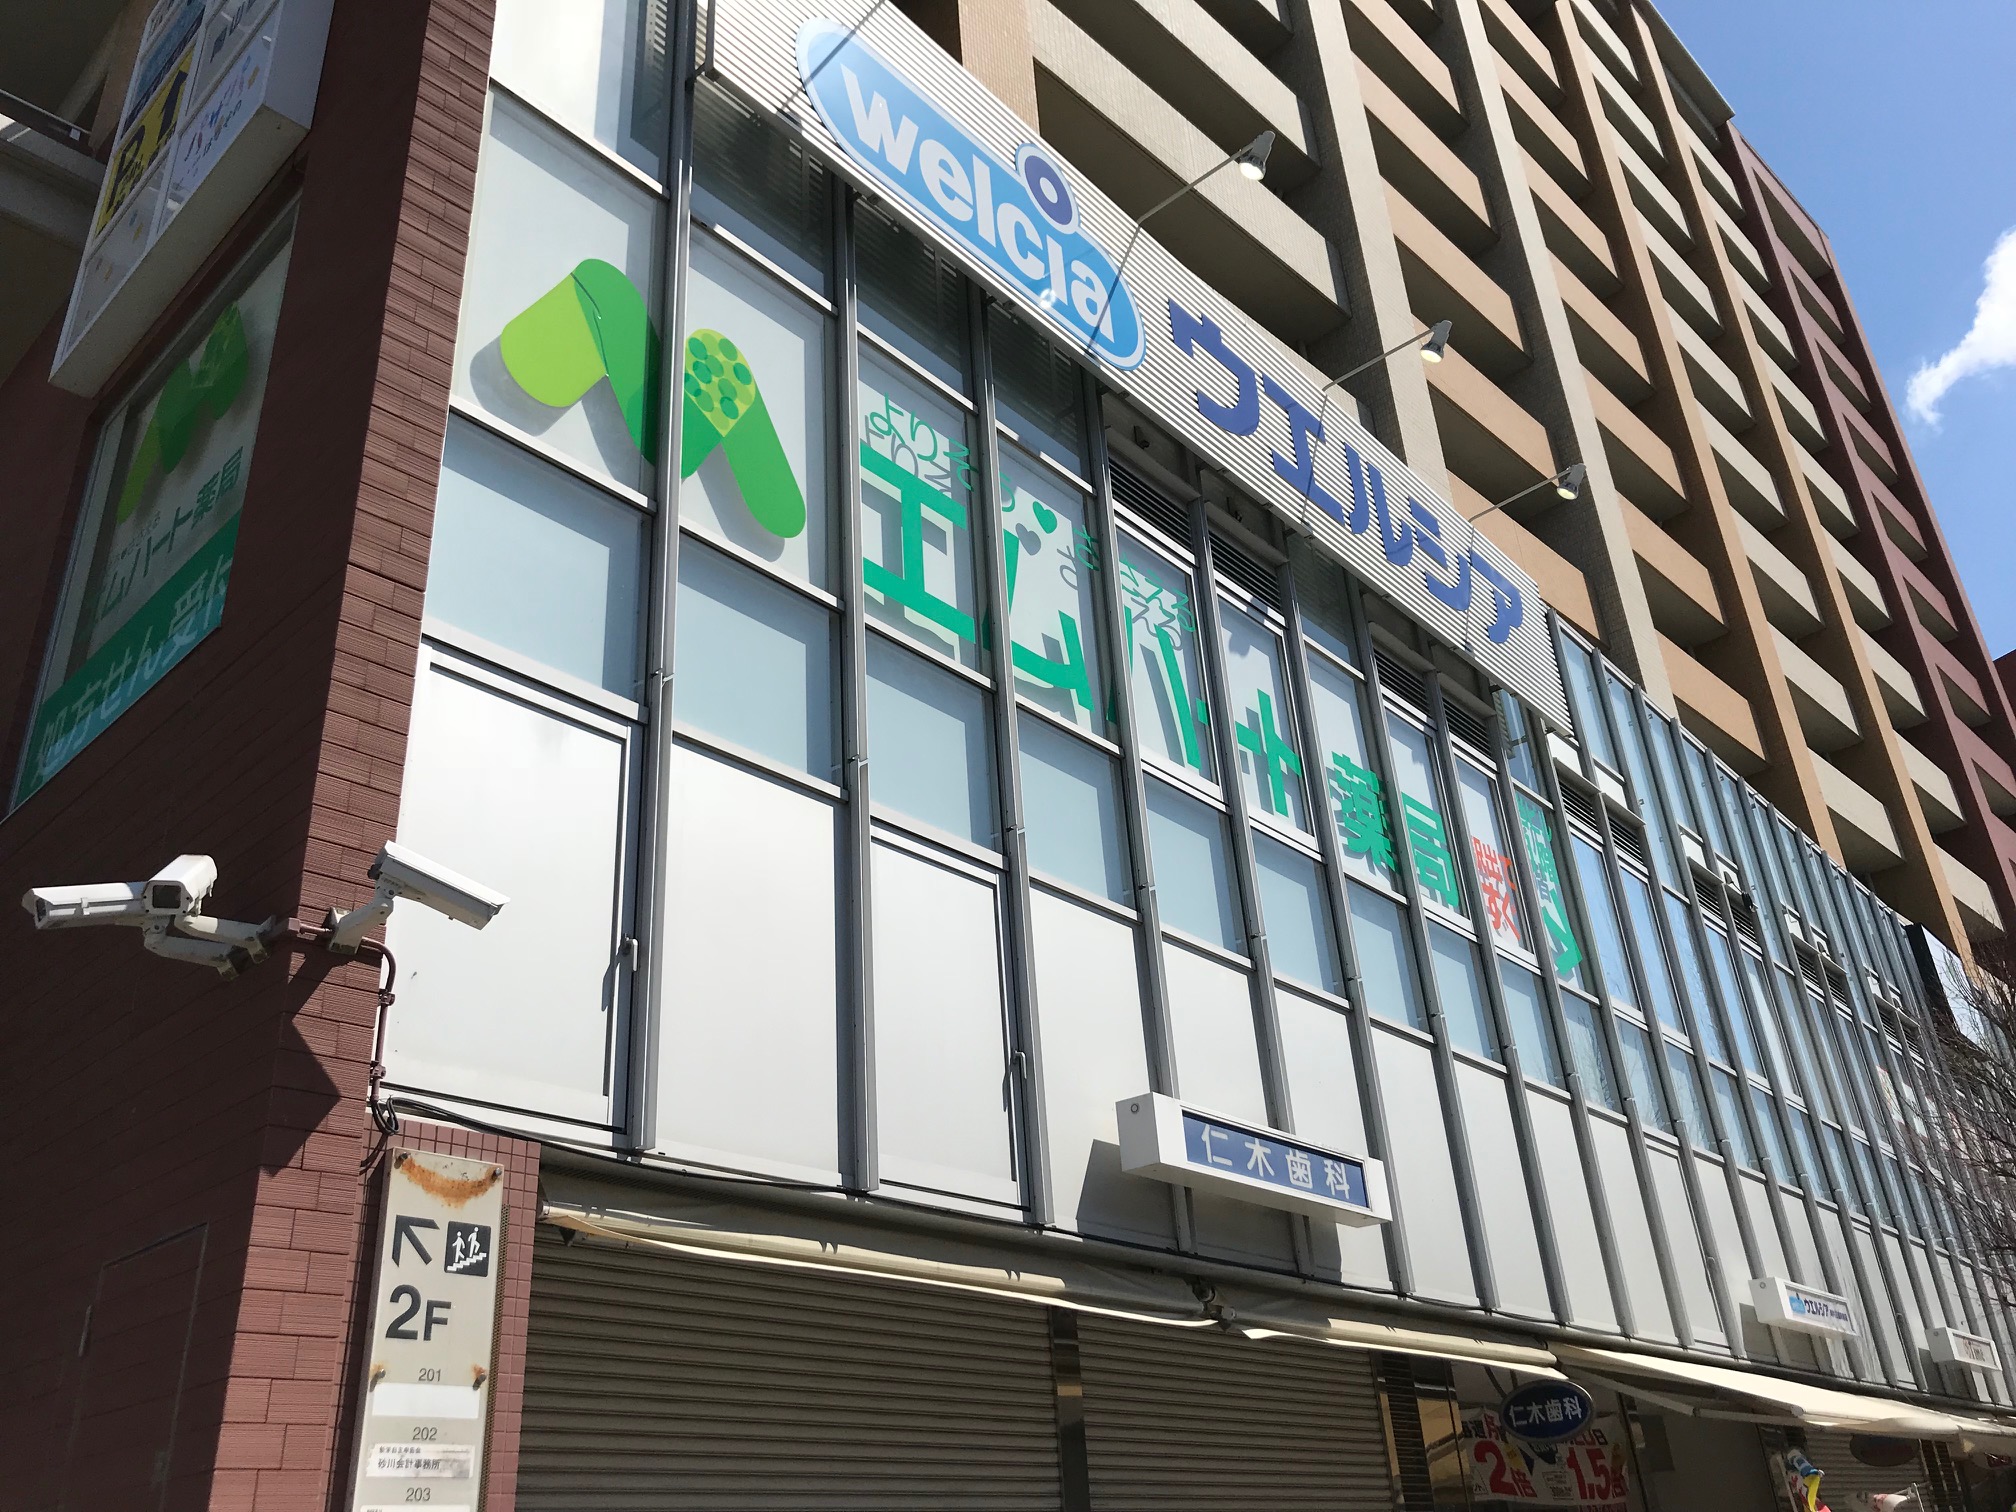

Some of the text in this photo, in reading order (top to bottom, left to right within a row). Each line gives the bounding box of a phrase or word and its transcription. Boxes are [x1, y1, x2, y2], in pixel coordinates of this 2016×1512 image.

[841, 62, 1116, 345] welcia
[1168, 298, 1523, 644] ウエルシア
[1201, 1123, 1351, 1200] 仁木歯科
[385, 1284, 452, 1342] 2F
[417, 1367, 442, 1383] 201
[1509, 1396, 1583, 1428] 仁木歯科
[412, 1427, 438, 1442] 202
[377, 1457, 441, 1471] 砂川会計事務所
[405, 1487, 431, 1502] 203
